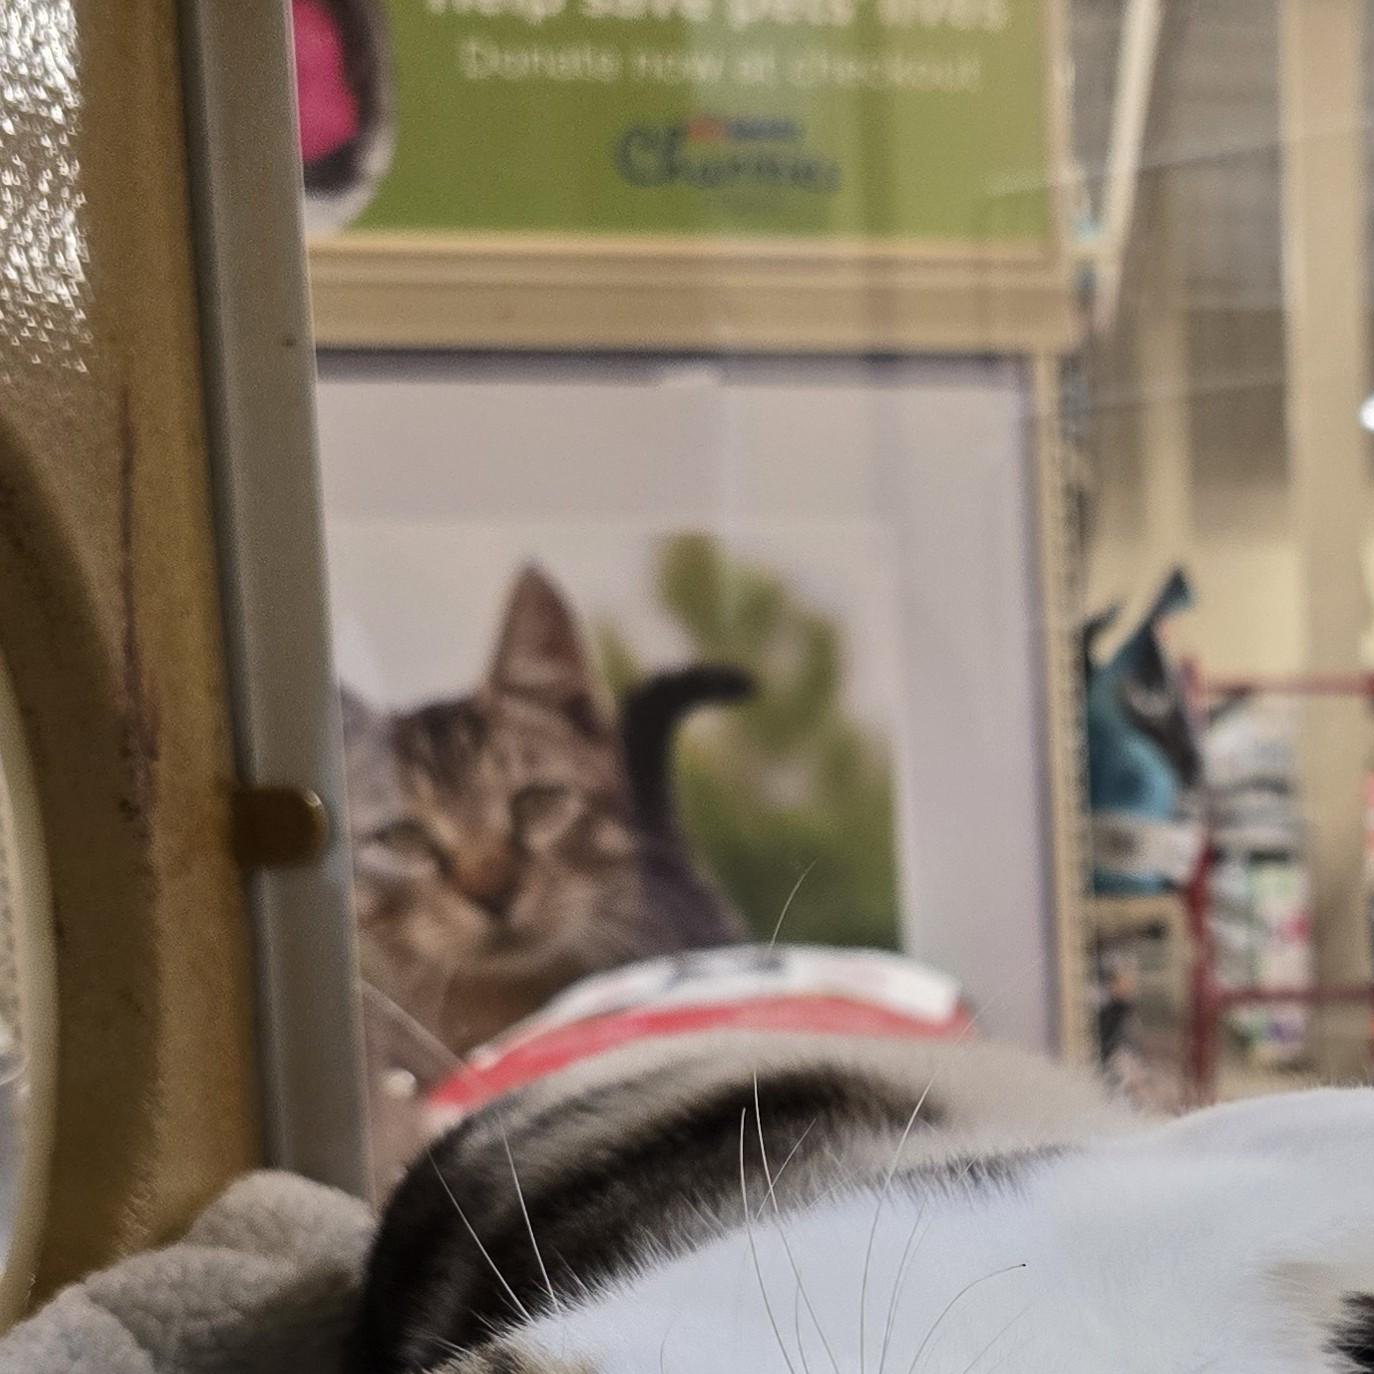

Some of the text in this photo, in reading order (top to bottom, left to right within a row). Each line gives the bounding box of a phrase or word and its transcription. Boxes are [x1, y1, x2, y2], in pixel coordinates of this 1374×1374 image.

[460, 41, 621, 82] Donate
[632, 54, 723, 84] now
[731, 50, 775, 86] at
